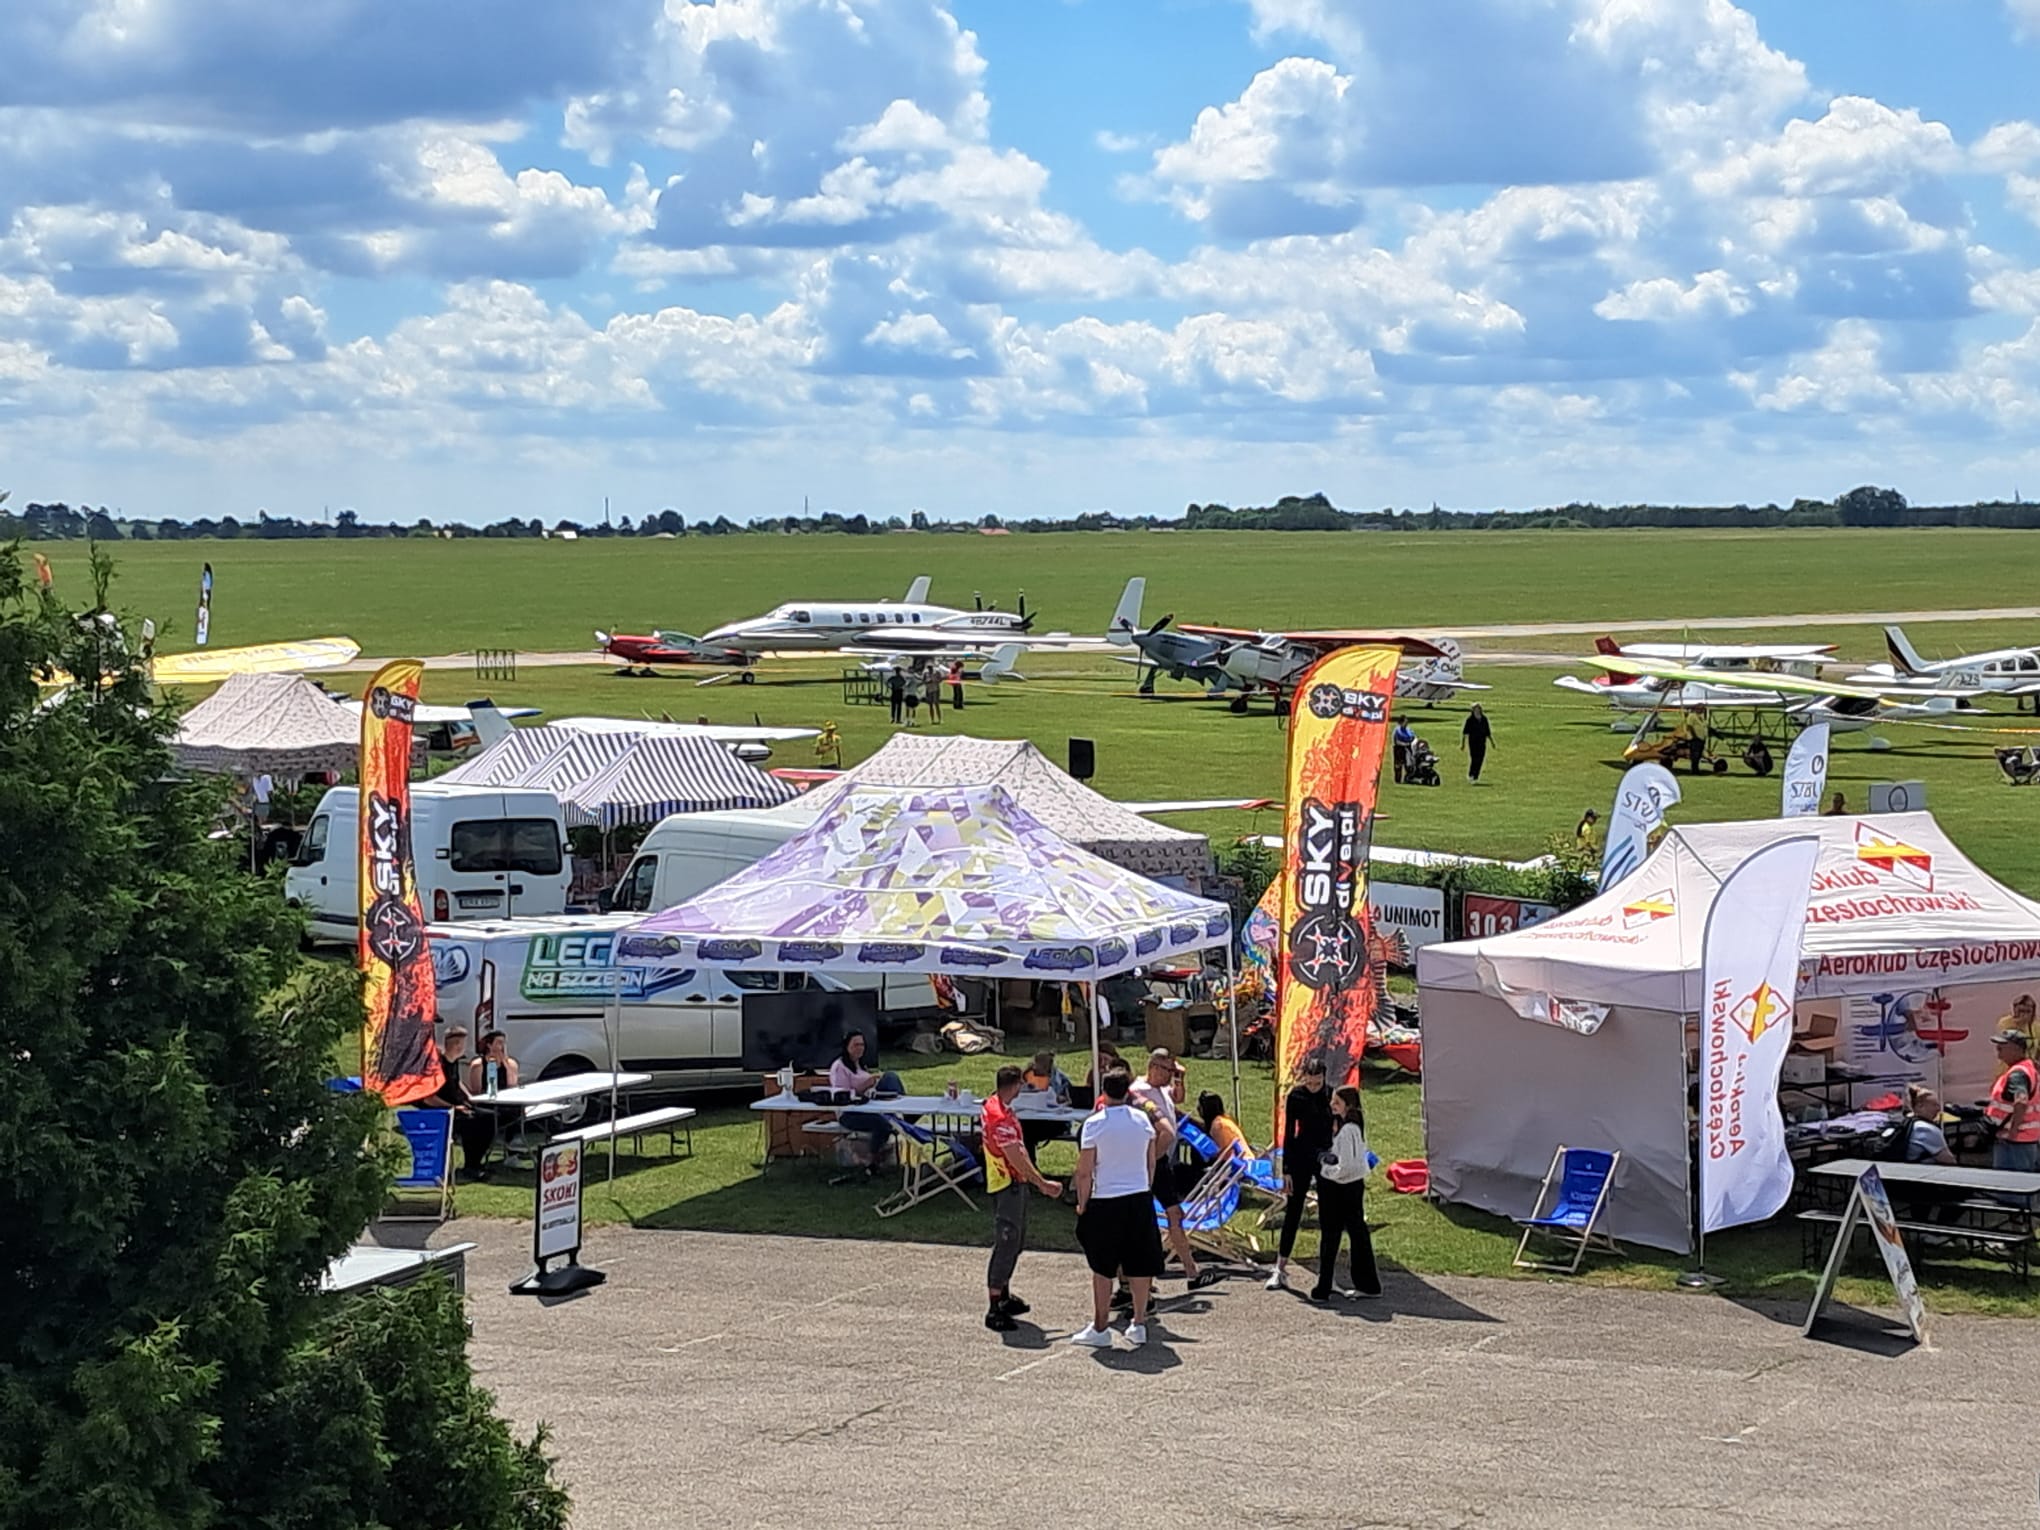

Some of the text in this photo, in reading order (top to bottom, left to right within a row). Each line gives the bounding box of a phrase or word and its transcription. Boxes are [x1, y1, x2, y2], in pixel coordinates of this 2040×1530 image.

[1343, 691, 1386, 708] SKY
[374, 796, 392, 891] SKY
[1304, 805, 1334, 906] SKY
[1384, 904, 1440, 929] UNIMOT
[1805, 891, 1982, 923] zęstochowski
[1470, 911, 1513, 937] 303
[1818, 940, 2040, 977] Aeroklub Częstochow
[526, 971, 556, 988] NA
